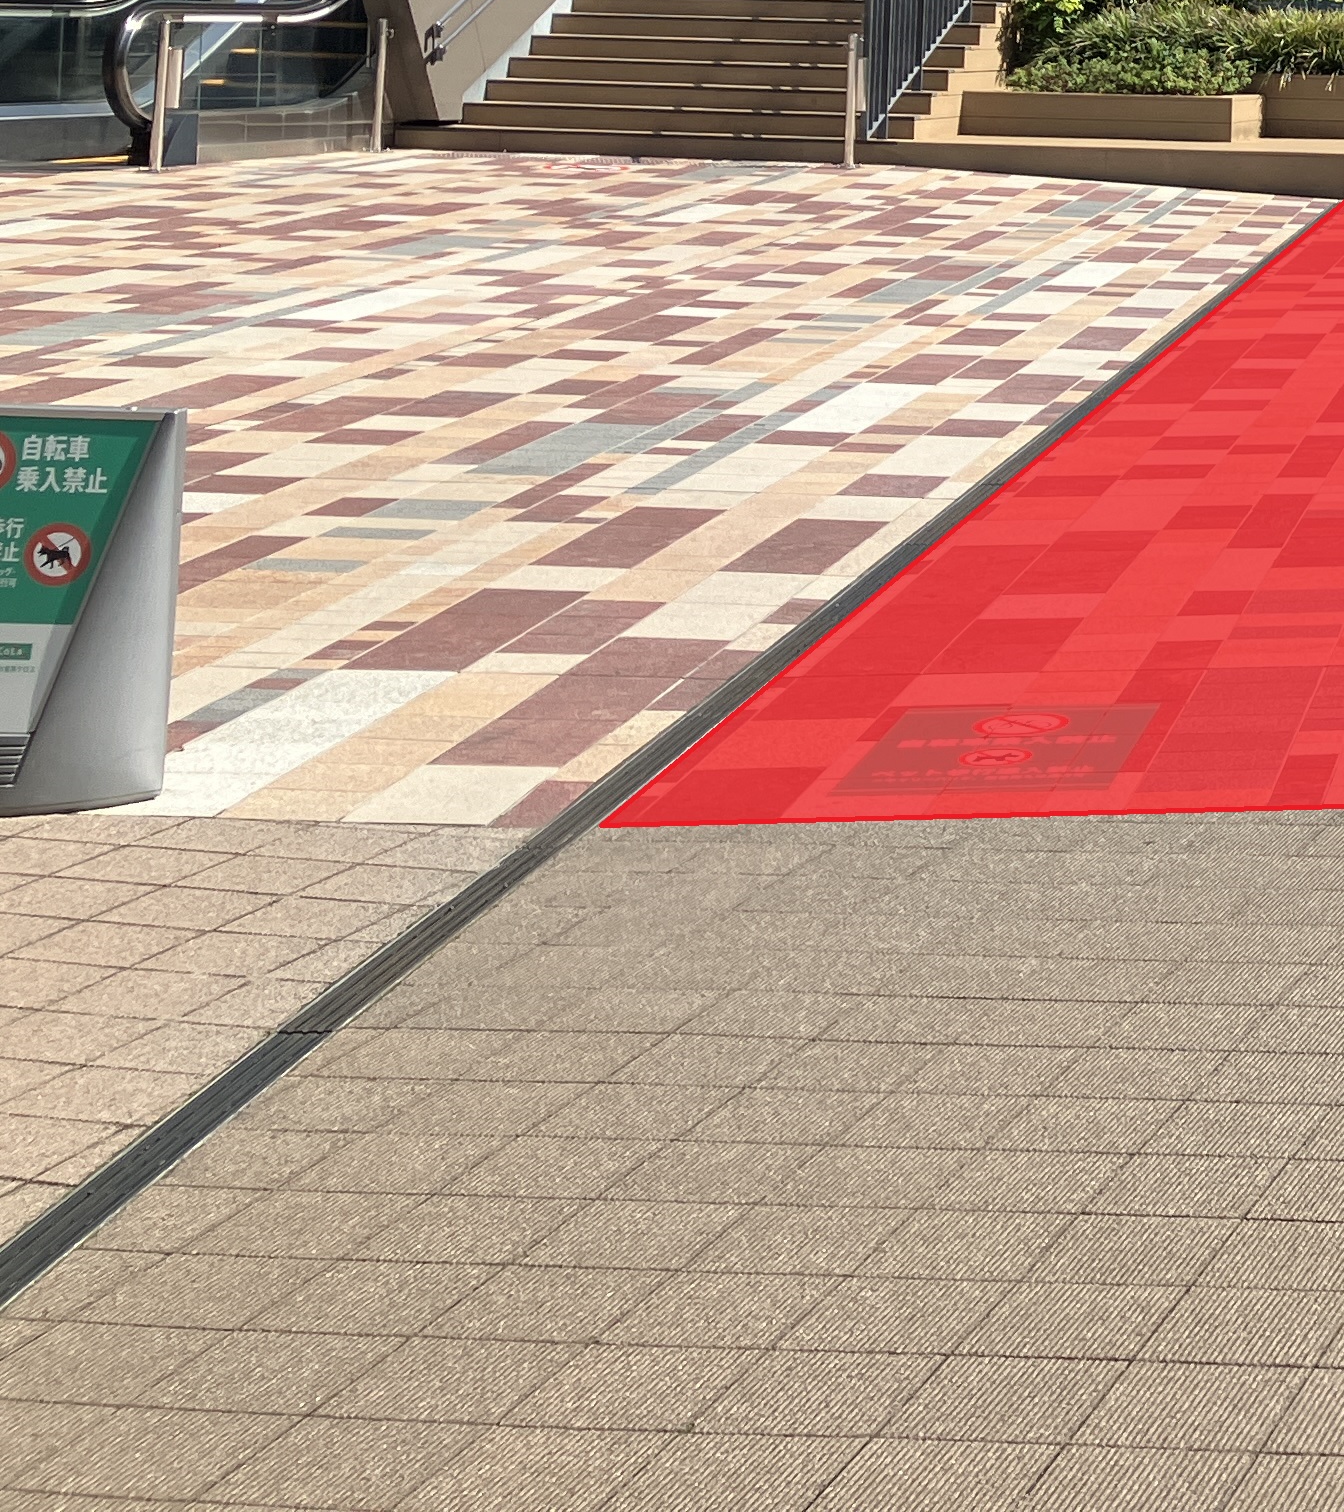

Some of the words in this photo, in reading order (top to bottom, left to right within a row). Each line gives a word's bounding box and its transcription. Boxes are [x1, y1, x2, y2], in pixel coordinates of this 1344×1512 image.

[21, 434, 91, 462] 自転車
[15, 467, 108, 494] 乗入禁止
[0, 517, 25, 539] 行
